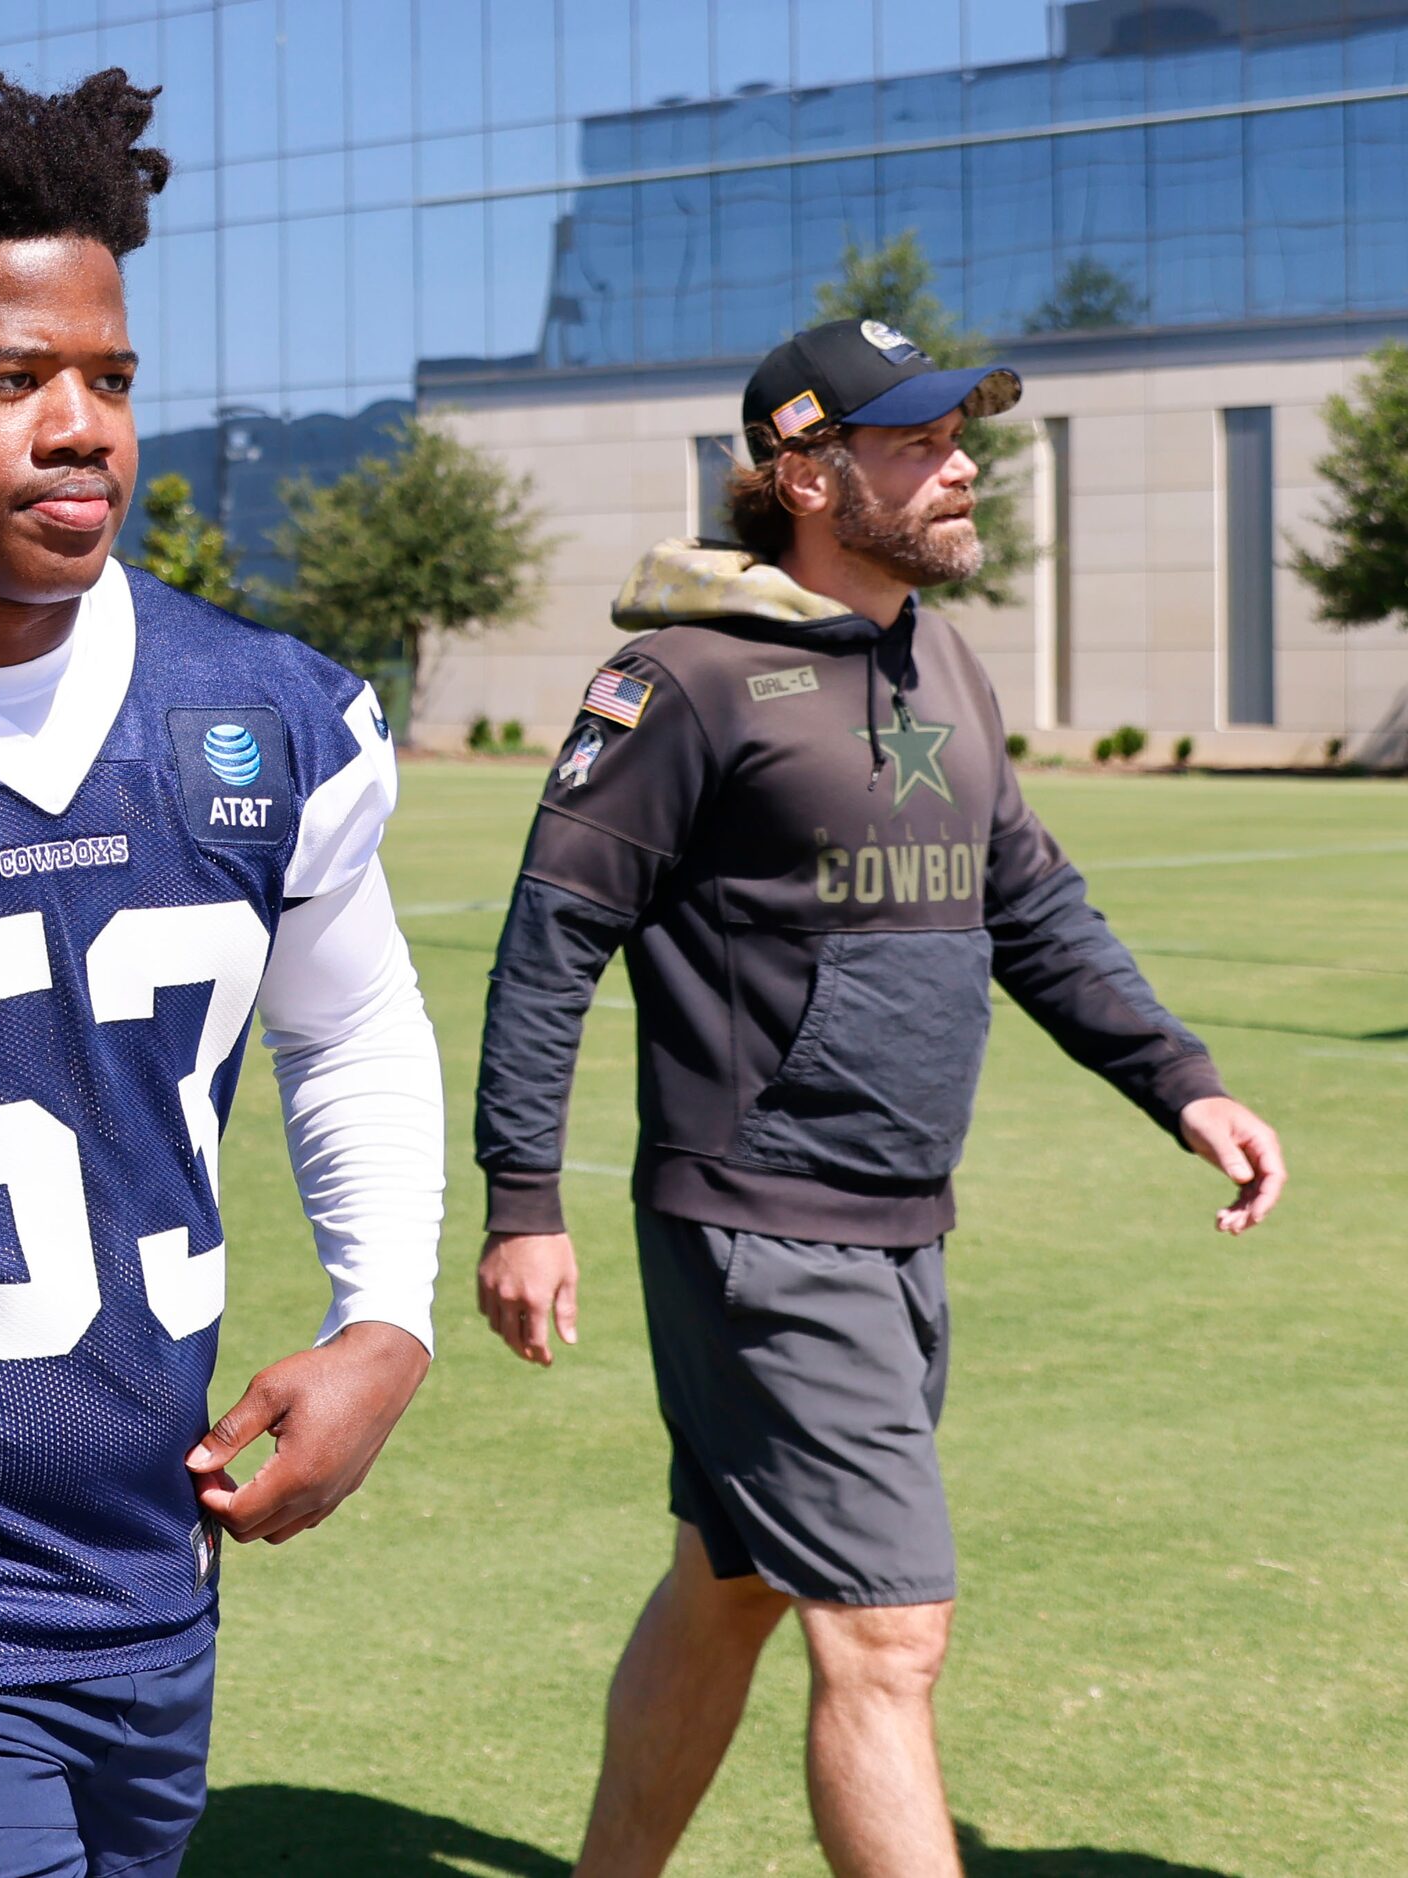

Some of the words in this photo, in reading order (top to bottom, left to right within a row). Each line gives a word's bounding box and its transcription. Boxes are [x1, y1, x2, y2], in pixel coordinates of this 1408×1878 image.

[752, 671, 813, 697] DAL-C
[210, 797, 273, 828] AT&T
[816, 842, 986, 904] COWBOY
